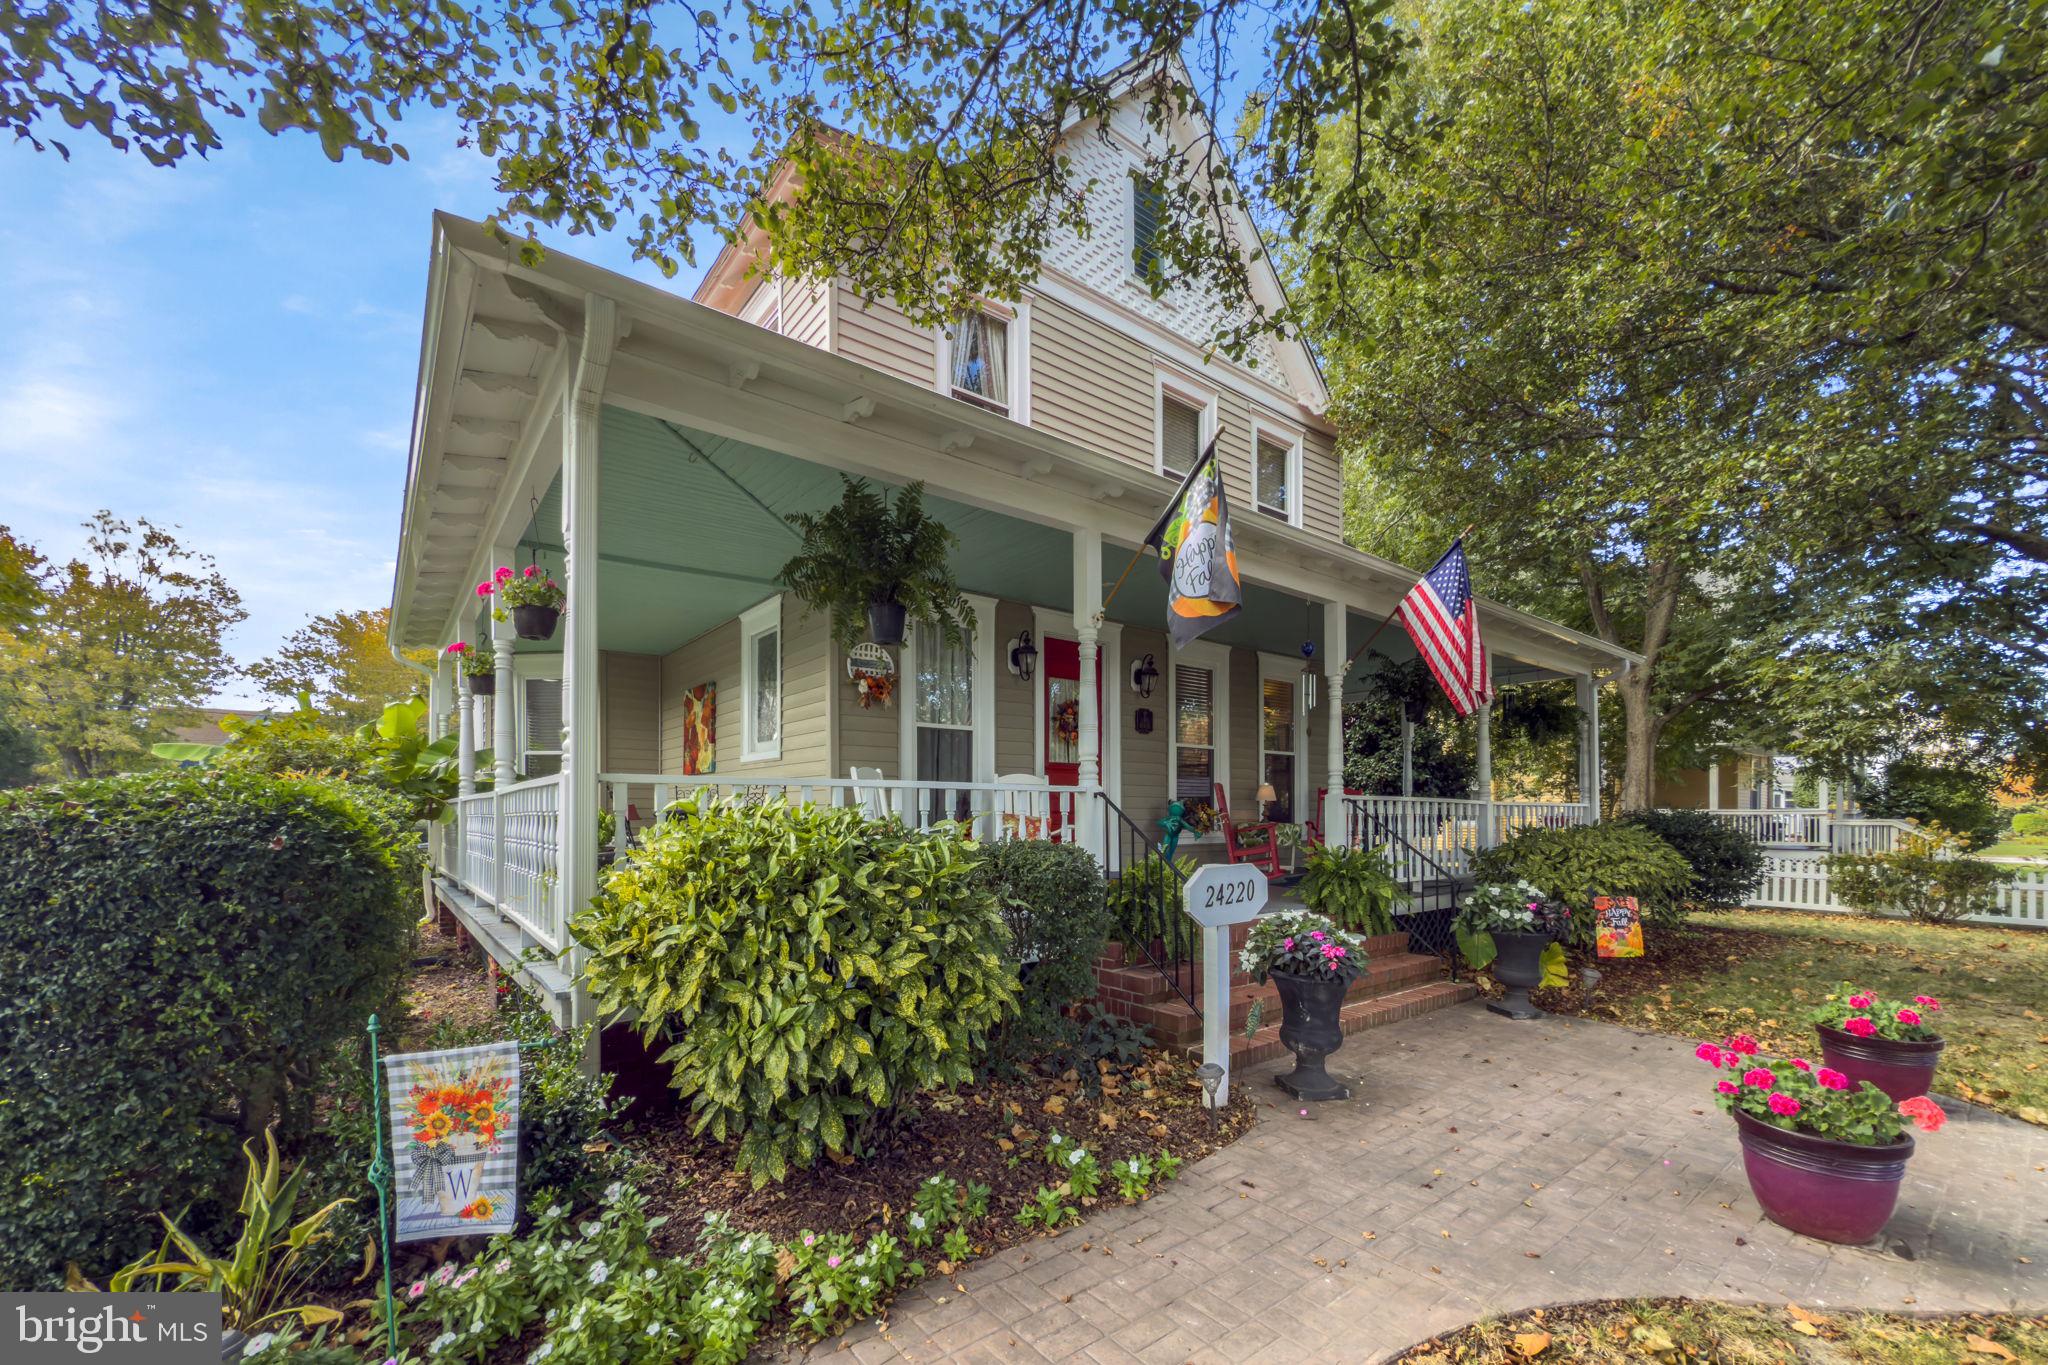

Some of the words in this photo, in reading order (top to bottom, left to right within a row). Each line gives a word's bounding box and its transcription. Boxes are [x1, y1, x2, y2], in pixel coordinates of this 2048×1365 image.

[1176, 535, 1217, 580] Happ
[1186, 560, 1213, 594] Fal
[1205, 879, 1255, 908] 24220
[447, 1168, 473, 1201] W
